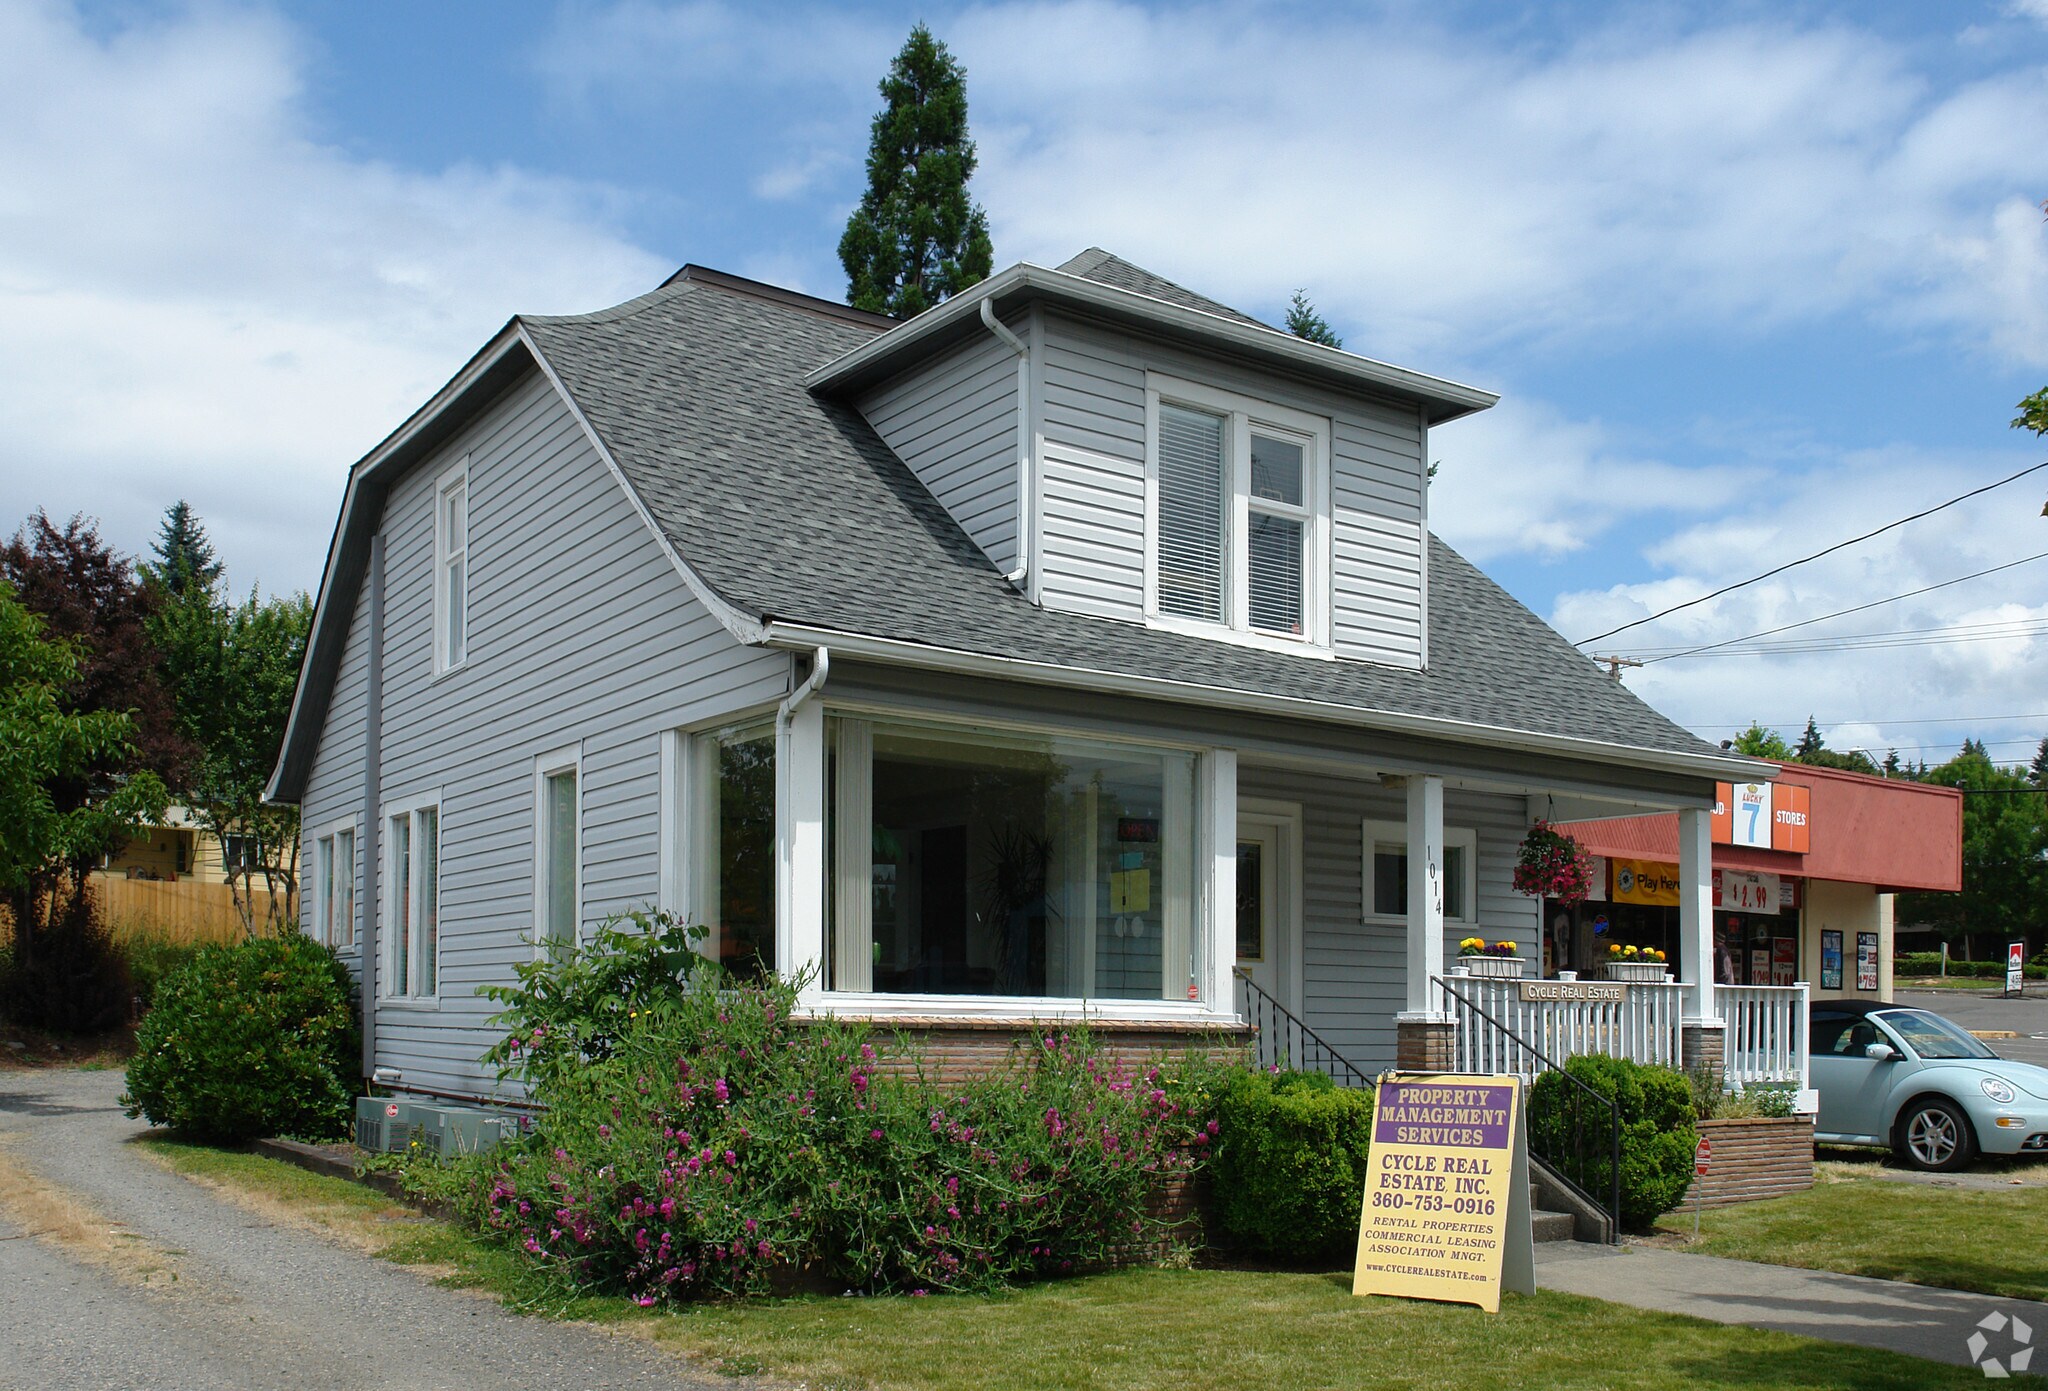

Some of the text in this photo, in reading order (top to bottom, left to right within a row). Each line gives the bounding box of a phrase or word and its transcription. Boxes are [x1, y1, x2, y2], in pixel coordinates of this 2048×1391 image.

[1742, 793, 1764, 804] LUCKY
[1742, 803, 1760, 843] 7
[1776, 810, 1807, 826] STORES
[1427, 845, 1441, 914] 1014
[1637, 873, 1657, 892] Play
[1528, 985, 1620, 999] CYCLE REAL ESTATE
[1398, 1088, 1490, 1106] PROPERTY
[1380, 1106, 1506, 1126] MANAGEMENT
[1397, 1126, 1483, 1145] SERVICES
[1381, 1154, 1493, 1175] CYCLE REAL
[1379, 1173, 1490, 1195] ESTATE, INC.
[1372, 1191, 1495, 1216] 360-753-0916
[1373, 1216, 1494, 1234] RENTAL PROPERTIES
[1365, 1229, 1496, 1249] COMMERCIAL LEASING
[1368, 1243, 1486, 1262] ASSOCIATION MNGT.
[1366, 1263, 1487, 1282] www.CYCLEREALESTATE.com
